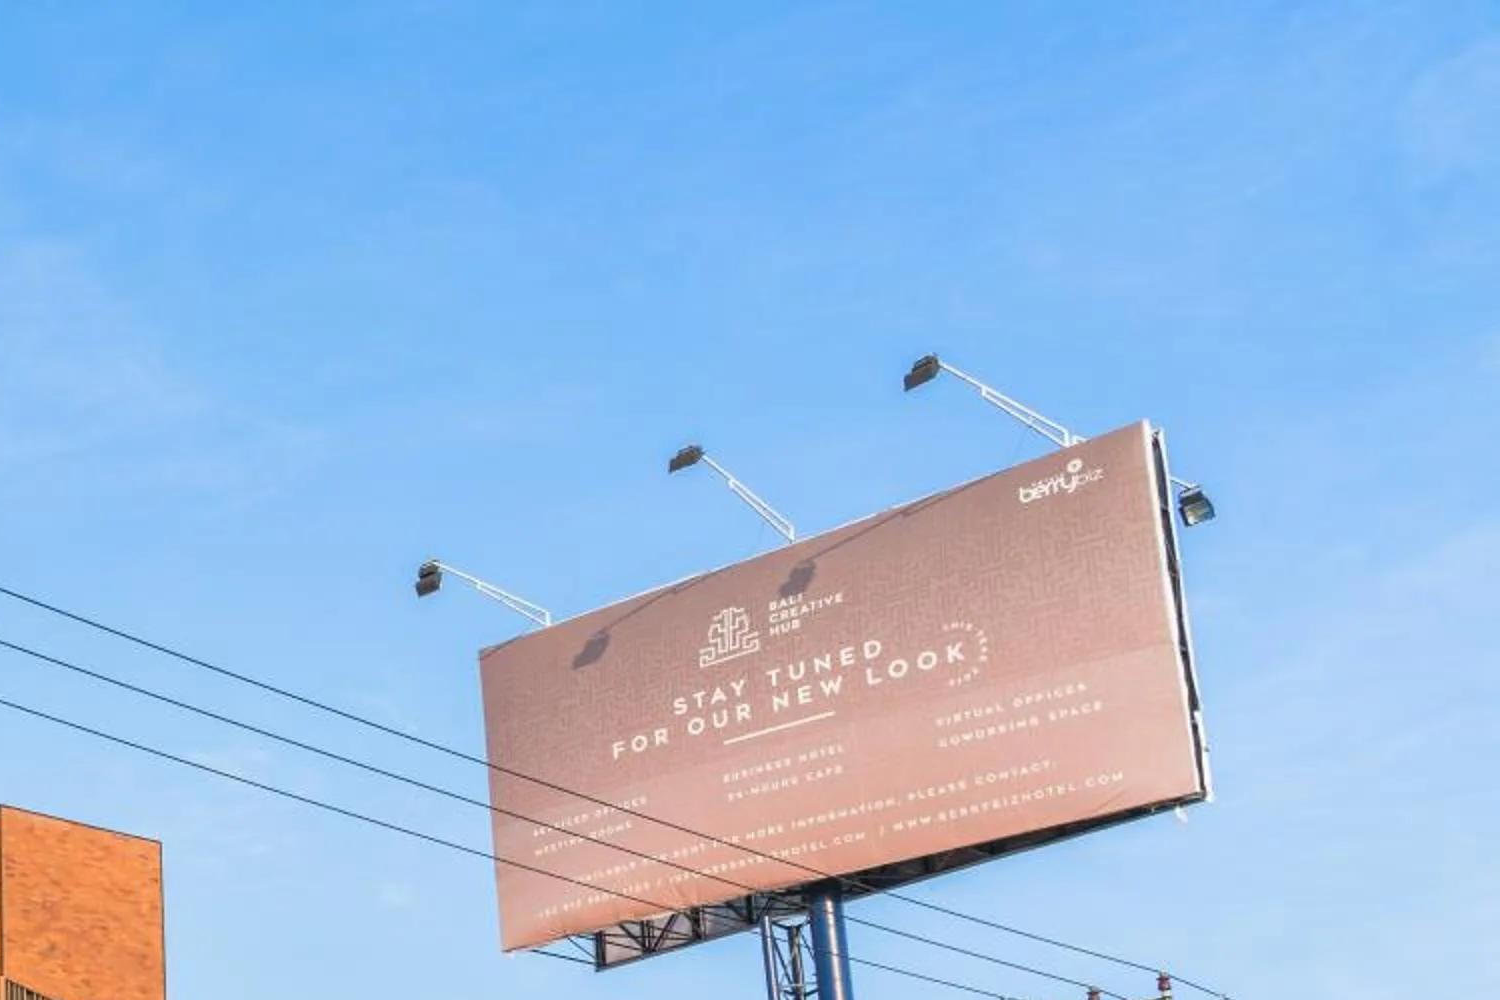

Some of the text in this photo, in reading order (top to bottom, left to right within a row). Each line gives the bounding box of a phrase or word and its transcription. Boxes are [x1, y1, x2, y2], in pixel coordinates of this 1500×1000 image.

[768, 592, 803, 611] BALI
[768, 592, 844, 623] CREATIVE
[768, 619, 801, 637] HUB
[672, 639, 883, 716] STAY TUNED
[611, 728, 670, 760] FOR
[687, 703, 752, 736] OUR
[772, 675, 844, 713] NEW
[866, 641, 966, 686] LOOK
[936, 703, 1005, 728] VIRTUAL
